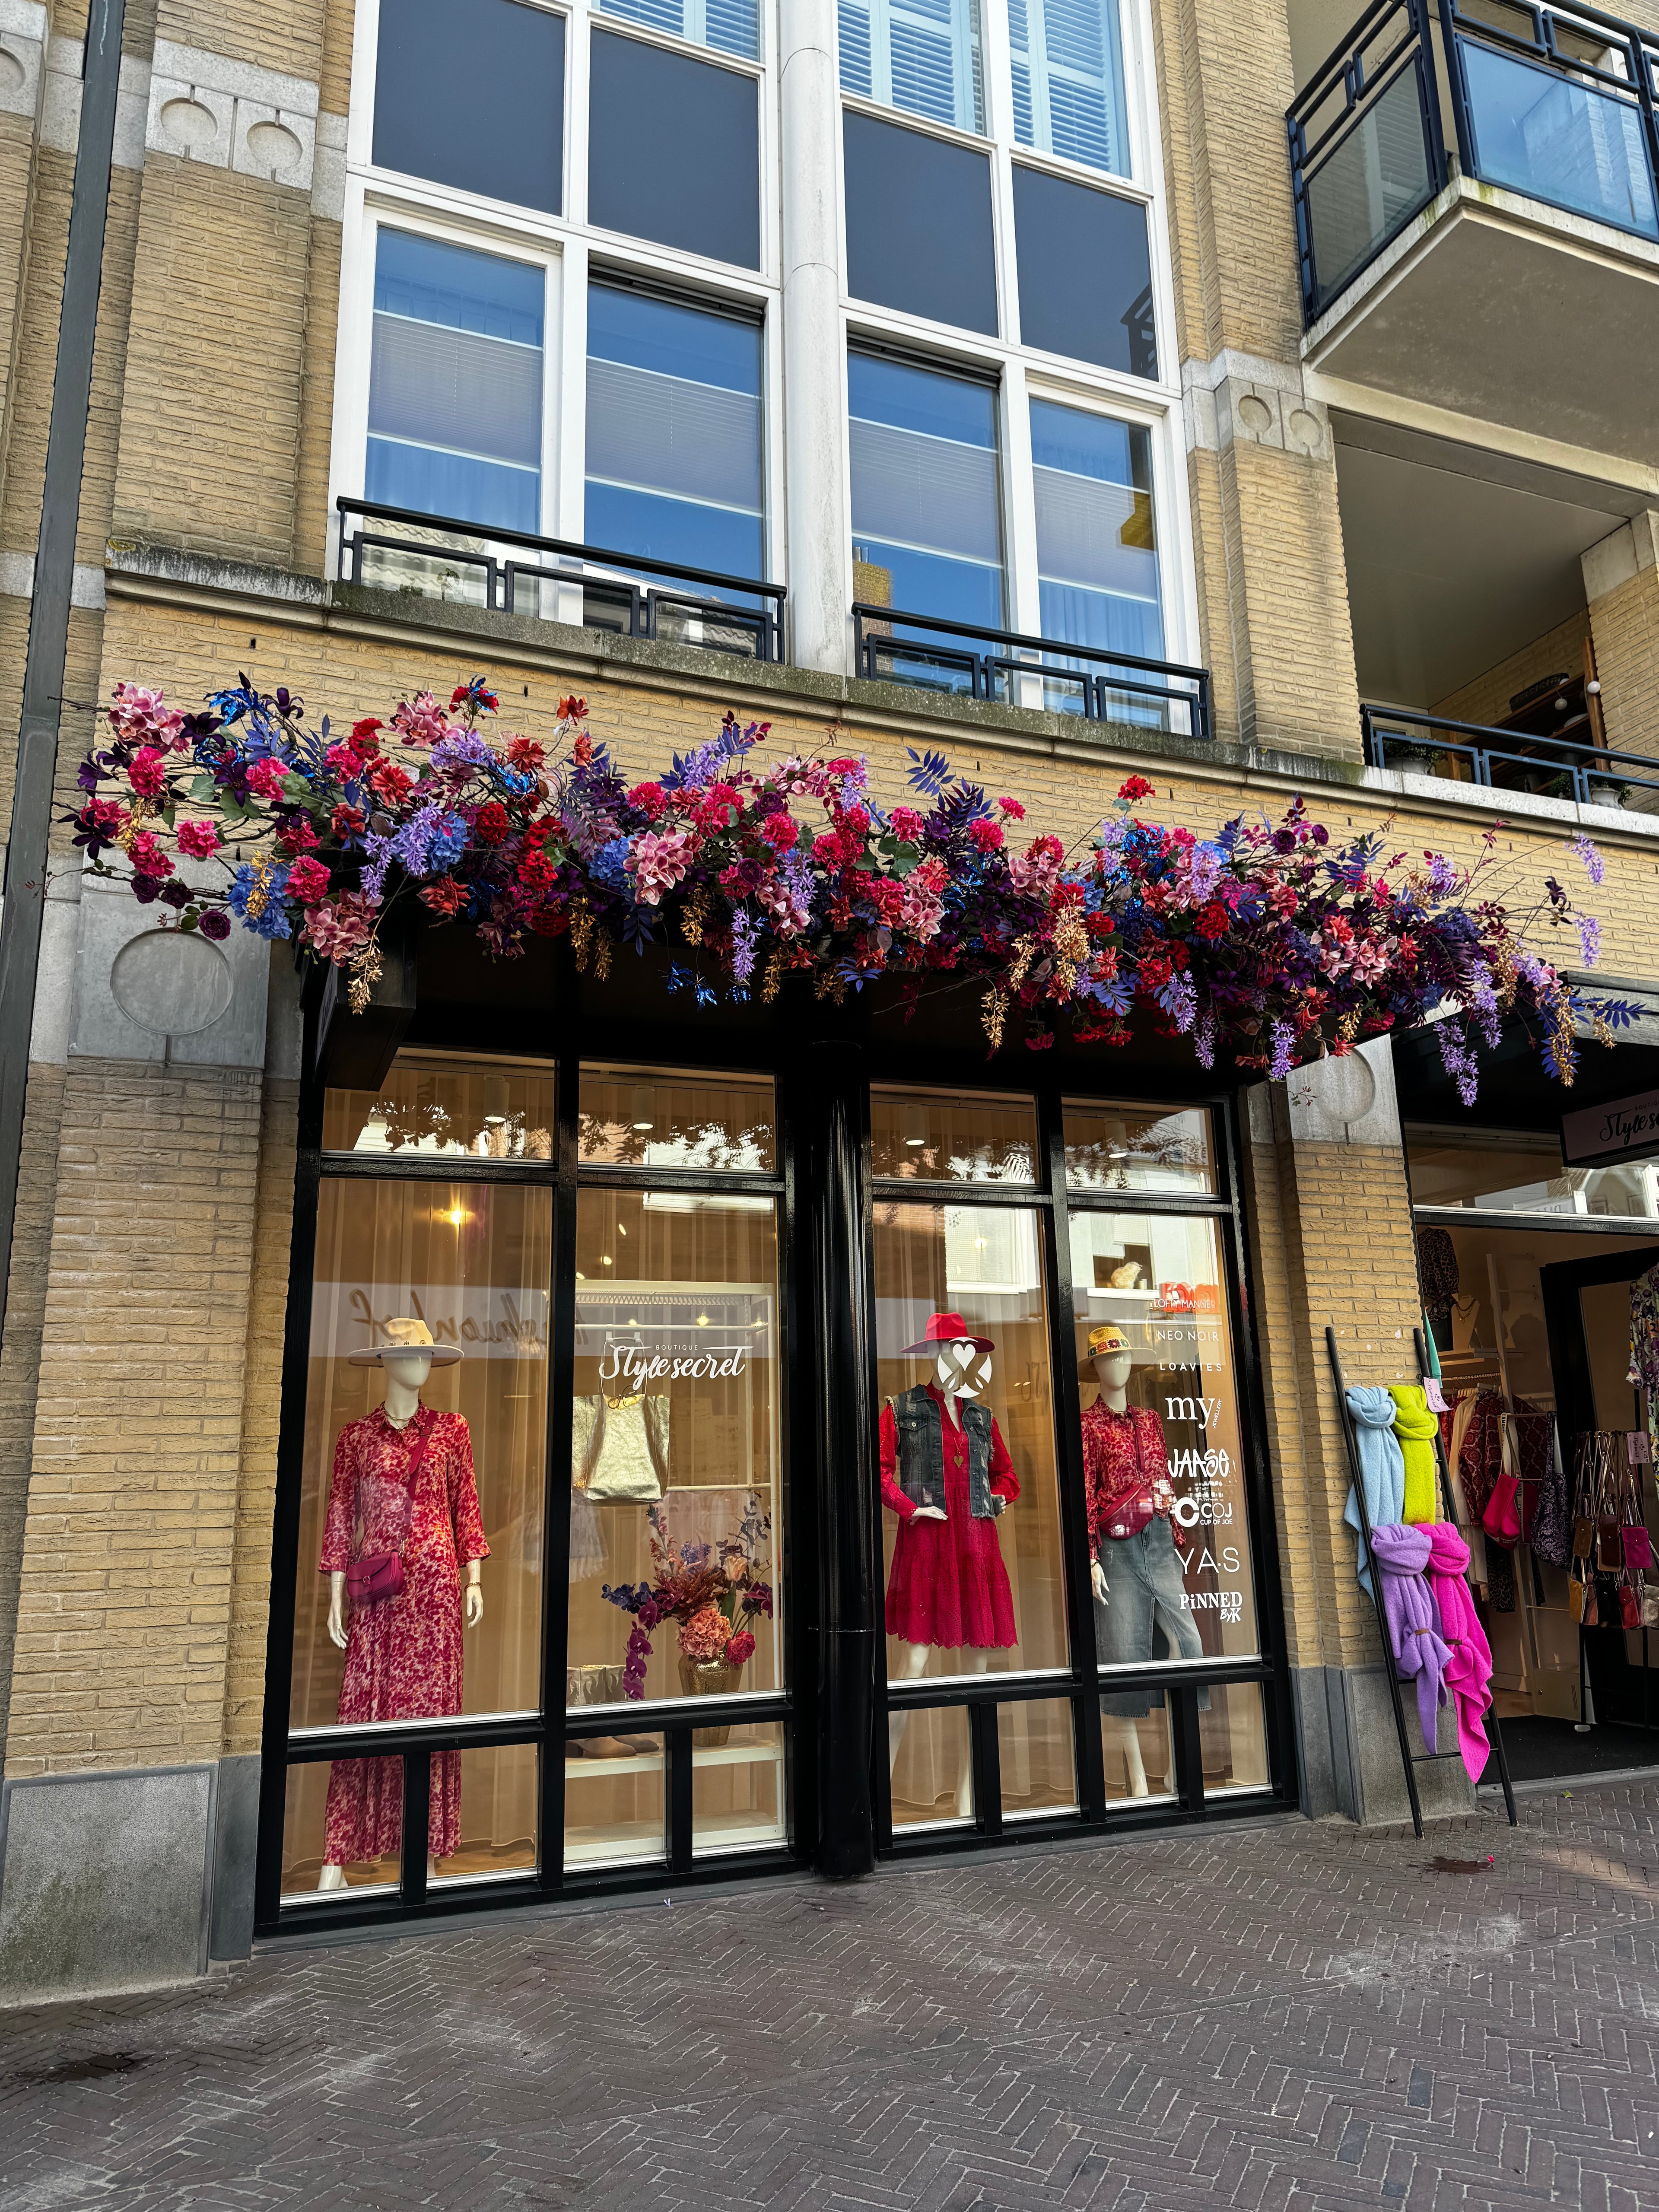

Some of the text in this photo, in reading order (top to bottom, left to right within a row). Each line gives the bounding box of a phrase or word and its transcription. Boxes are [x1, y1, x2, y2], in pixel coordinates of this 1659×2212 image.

[1154, 1299, 1215, 1309] LOFTY MANNER
[1157, 1330, 1219, 1341] NEO NOIR
[1160, 1362, 1222, 1372] LOAVIES
[1165, 1397, 1222, 1430] my JEWELLERY
